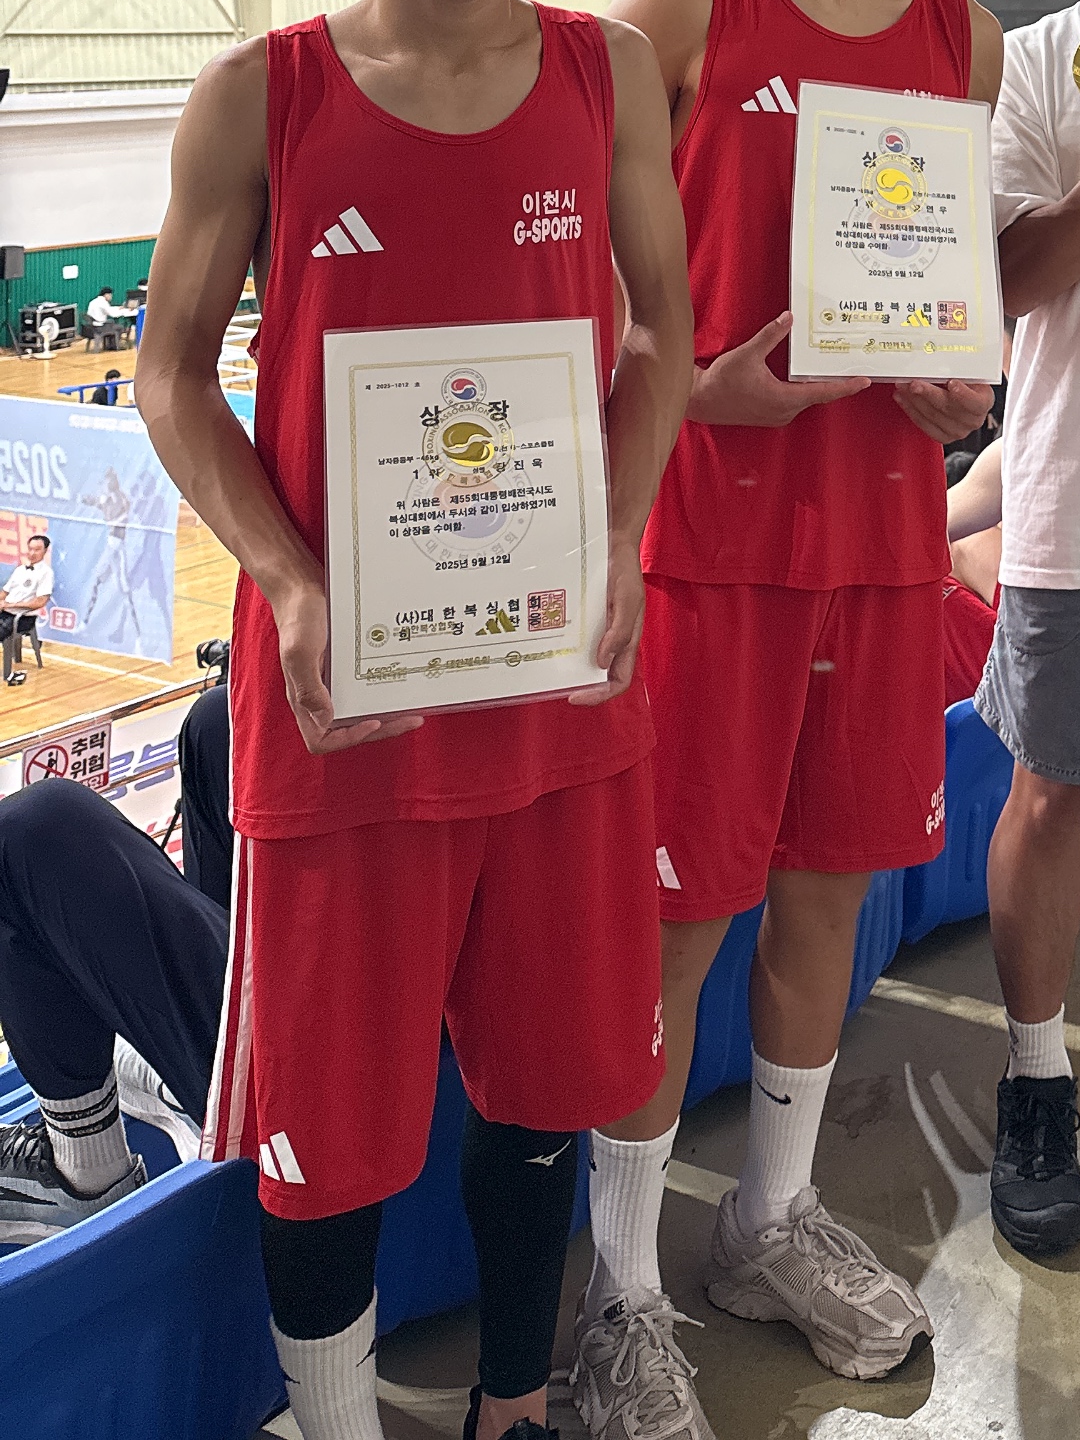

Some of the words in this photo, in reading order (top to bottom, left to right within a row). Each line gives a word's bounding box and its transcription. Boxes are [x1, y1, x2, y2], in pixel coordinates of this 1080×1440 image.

[862, 152, 877, 168] 상
[522, 188, 576, 216] 이천시
[513, 215, 582, 246] G-SPORTS
[420, 405, 440, 427] 상
[488, 400, 509, 421] 장
[412, 469, 419, 479] 1
[514, 460, 525, 471] 진
[388, 511, 446, 525] 복싱대회에서
[480, 504, 499, 515] 같이
[501, 498, 556, 513] 입상하였기에
[396, 501, 405, 510] 위
[411, 497, 440, 509] 사람은
[389, 528, 399, 538] 이
[402, 525, 431, 537] 상장을
[435, 559, 469, 571] 2025년
[471, 556, 487, 567] 9월
[490, 553, 511, 565] 12일
[71, 730, 107, 757] 추락
[69, 751, 105, 779] 위험
